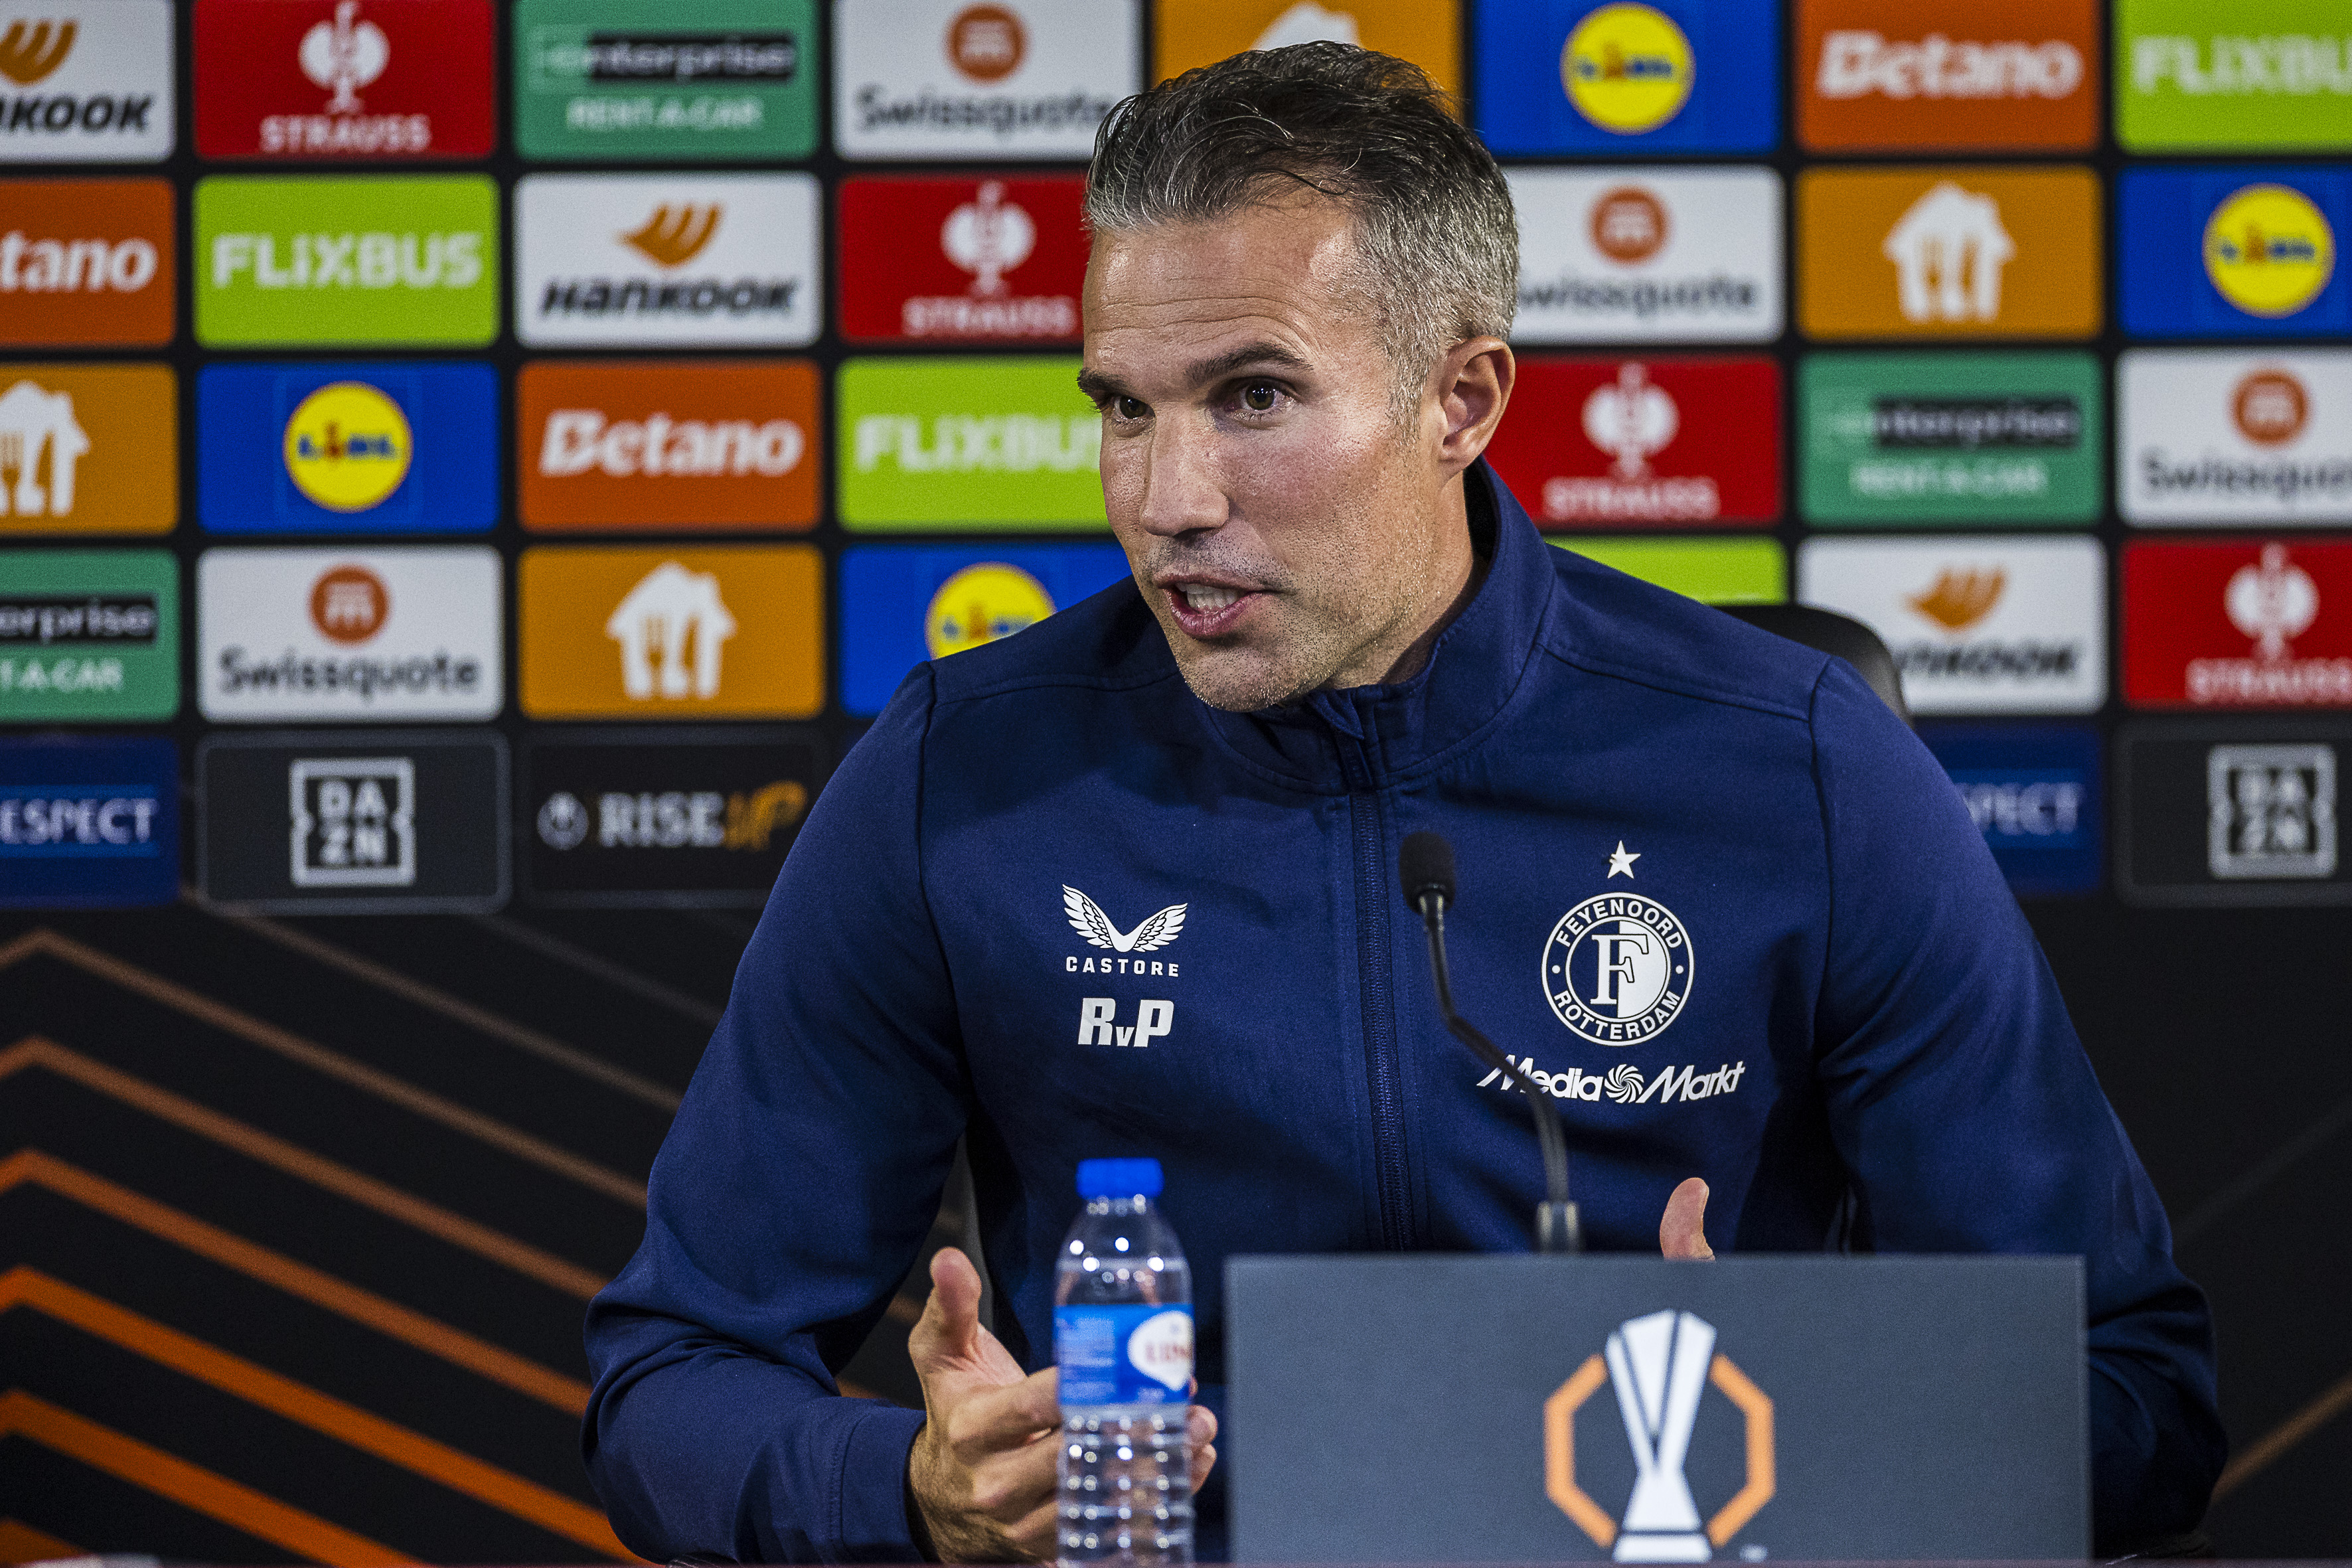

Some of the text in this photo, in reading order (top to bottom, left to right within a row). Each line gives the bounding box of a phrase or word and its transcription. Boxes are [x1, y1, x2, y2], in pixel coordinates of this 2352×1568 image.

[1817, 31, 2083, 98] Betano
[0, 95, 153, 133] KOOK
[260, 114, 431, 153] STRAUSS
[1516, 270, 1757, 320] wissquote
[538, 410, 805, 476] Betano
[218, 645, 479, 702] Swissquote
[1555, 899, 1683, 949] FEYENOORD
[1065, 956, 1179, 977] CASTORE
[1590, 934, 1649, 1005] F
[1077, 997, 1174, 1048] RvP
[1554, 990, 1681, 1040] ROTTERDAM
[1476, 1054, 1745, 1103] Media Markt
